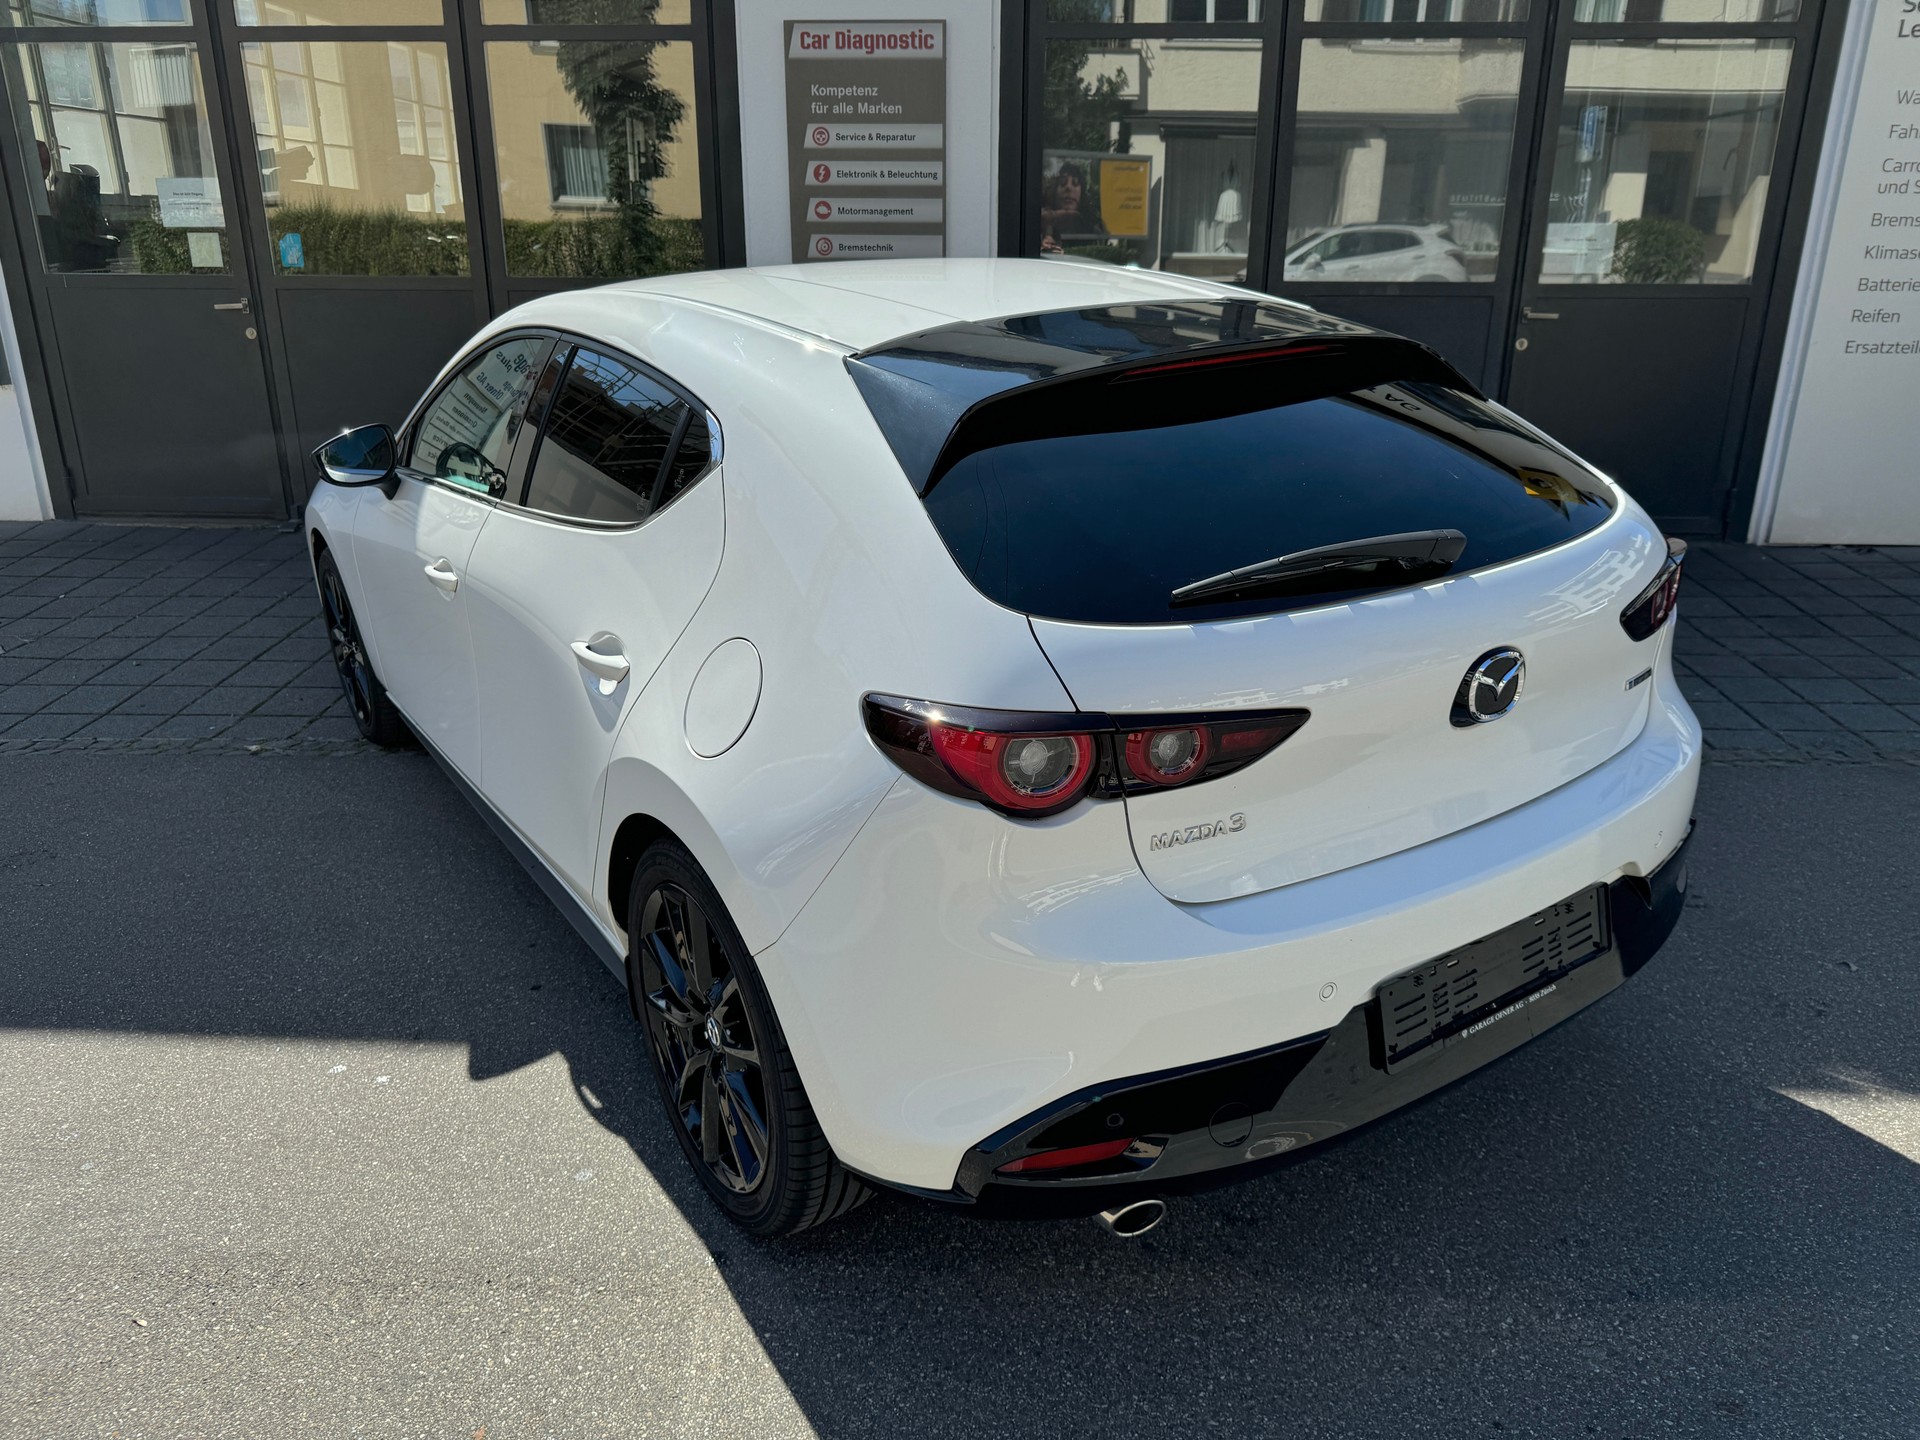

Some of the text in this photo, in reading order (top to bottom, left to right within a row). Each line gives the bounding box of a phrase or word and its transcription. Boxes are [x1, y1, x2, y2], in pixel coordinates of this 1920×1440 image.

[1902, 0, 1920, 13] S
[800, 29, 935, 55] Car Diagnostic
[811, 84, 878, 99] Kompetenz
[811, 102, 902, 114] für alle Marken
[835, 132, 916, 143] Service & Reparatur
[1889, 123, 1920, 139] Fah
[836, 169, 938, 180] Elektronik & Beleuchtung
[1877, 179, 1910, 194] und
[837, 207, 914, 217] Motormanagement
[838, 243, 894, 252] Bremstechnik
[1864, 244, 1920, 260] Klimas
[1858, 277, 1920, 292] Batterie
[1851, 308, 1900, 323] Reifen
[1845, 339, 1920, 354] Ersatzteil
[1469, 1016, 1496, 1034] GARAGE
[1515, 1001, 1524, 1011] AG
